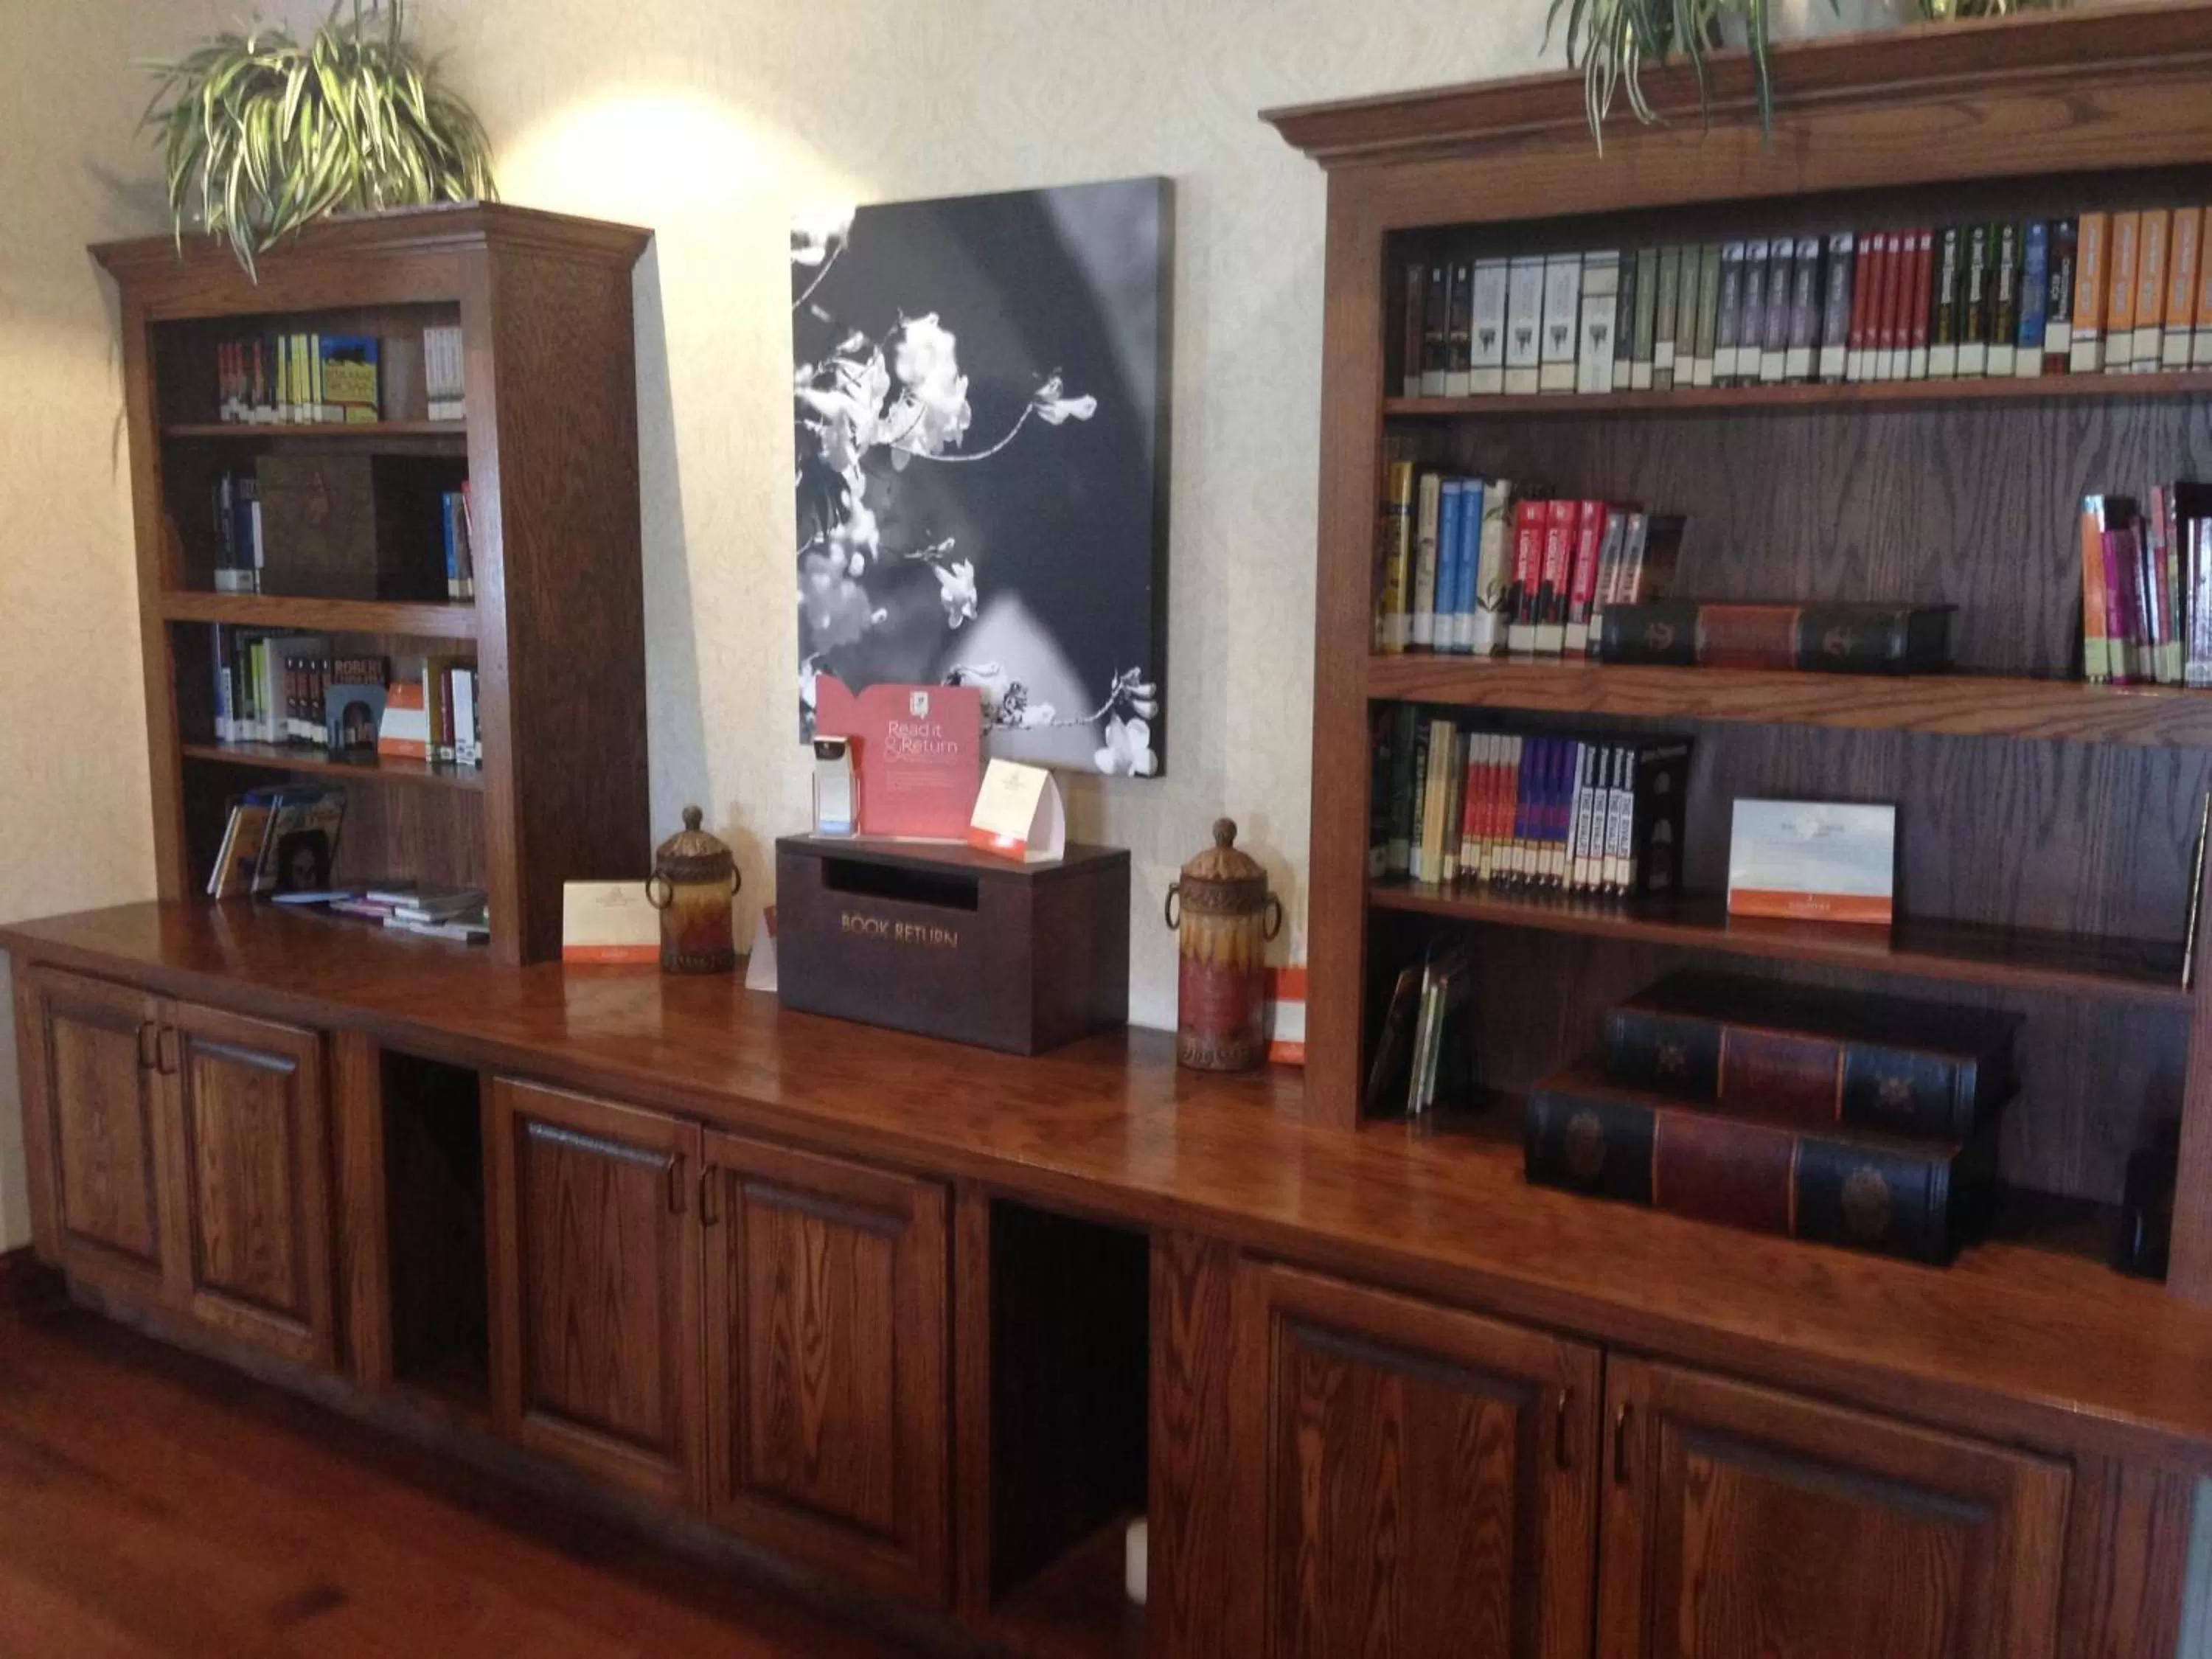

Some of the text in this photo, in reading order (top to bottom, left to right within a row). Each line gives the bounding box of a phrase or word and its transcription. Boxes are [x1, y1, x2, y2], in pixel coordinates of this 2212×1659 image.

[888, 720, 942, 738] Read it
[902, 737, 958, 754] Return
[841, 913, 959, 946] BOOK RETURN
